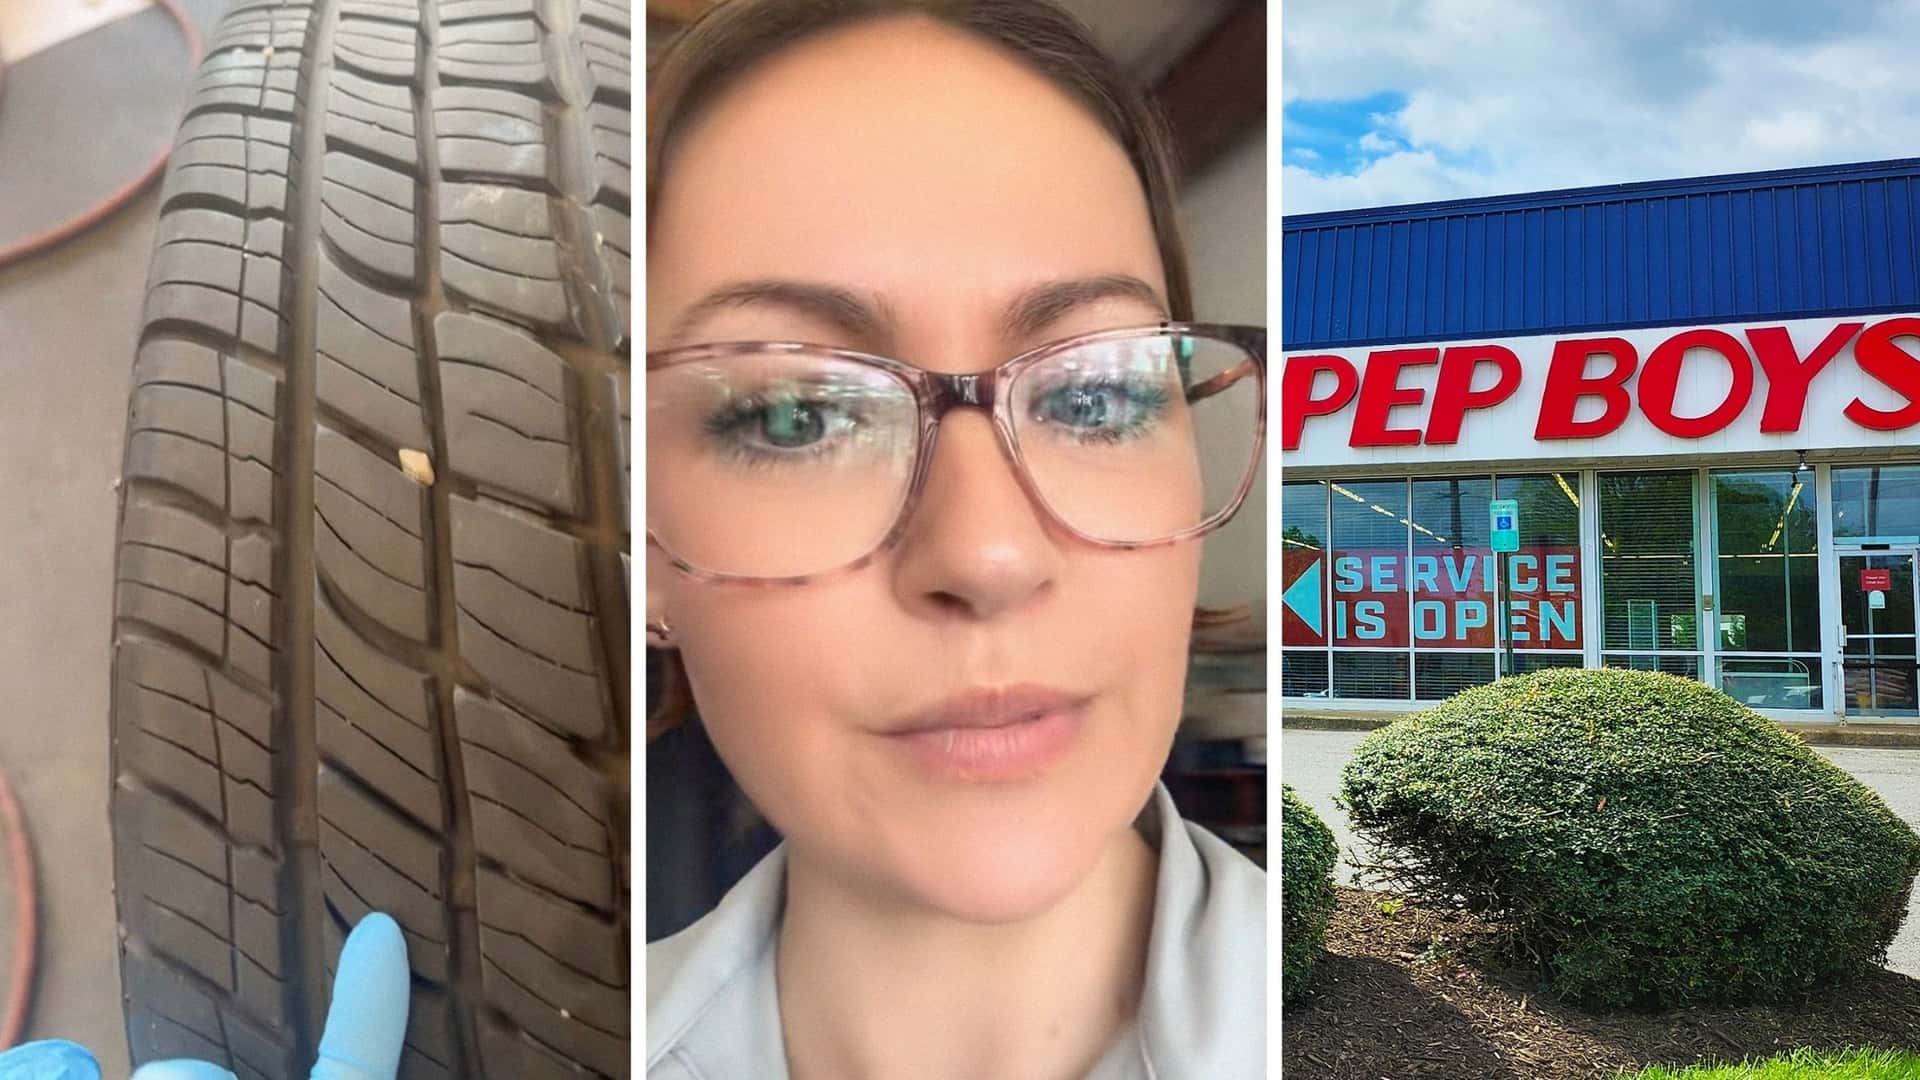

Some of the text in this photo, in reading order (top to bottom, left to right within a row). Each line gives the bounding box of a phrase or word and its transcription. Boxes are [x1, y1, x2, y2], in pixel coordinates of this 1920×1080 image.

[1282, 317, 1920, 451] PEP BOYS
[1335, 555, 1575, 593] SERVICE
[1336, 600, 1576, 641] IS OPEN
